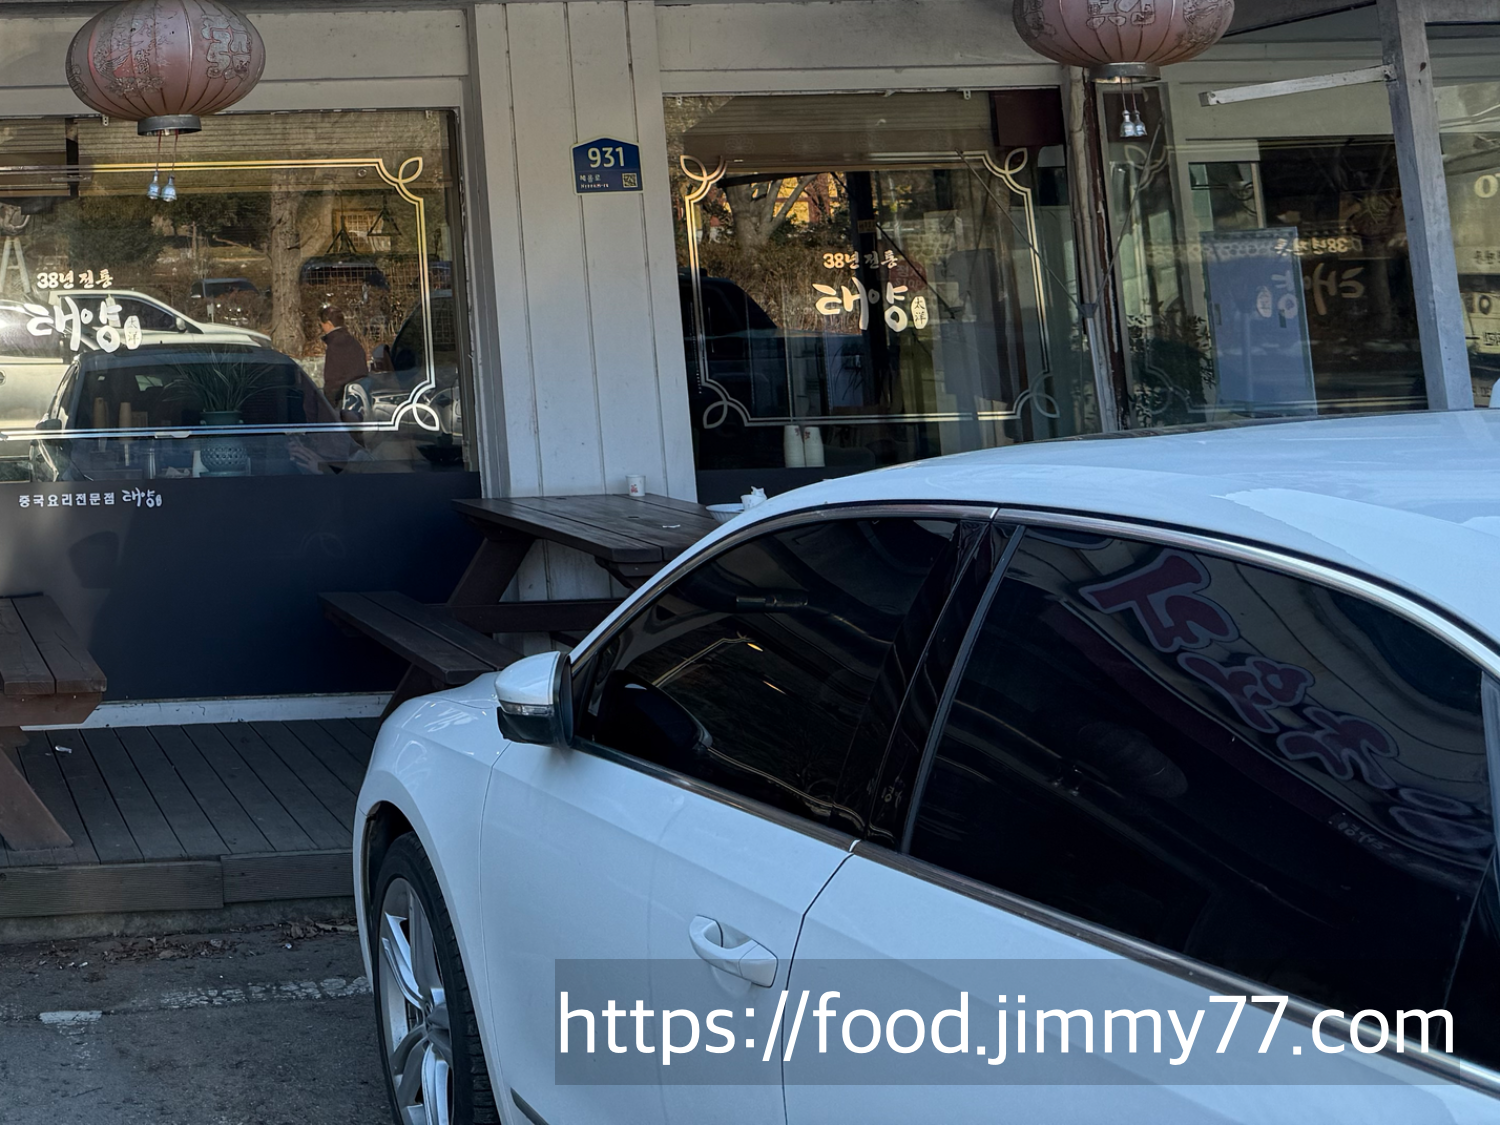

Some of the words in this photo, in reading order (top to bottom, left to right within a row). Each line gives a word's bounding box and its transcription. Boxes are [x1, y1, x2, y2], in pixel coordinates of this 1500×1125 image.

[587, 147, 625, 168] 931
[823, 251, 859, 269] 38년
[37, 270, 74, 289] 38년
[812, 277, 908, 332] 태양
[24, 296, 122, 353] 태양
[18, 492, 115, 508] 중국요리전문점
